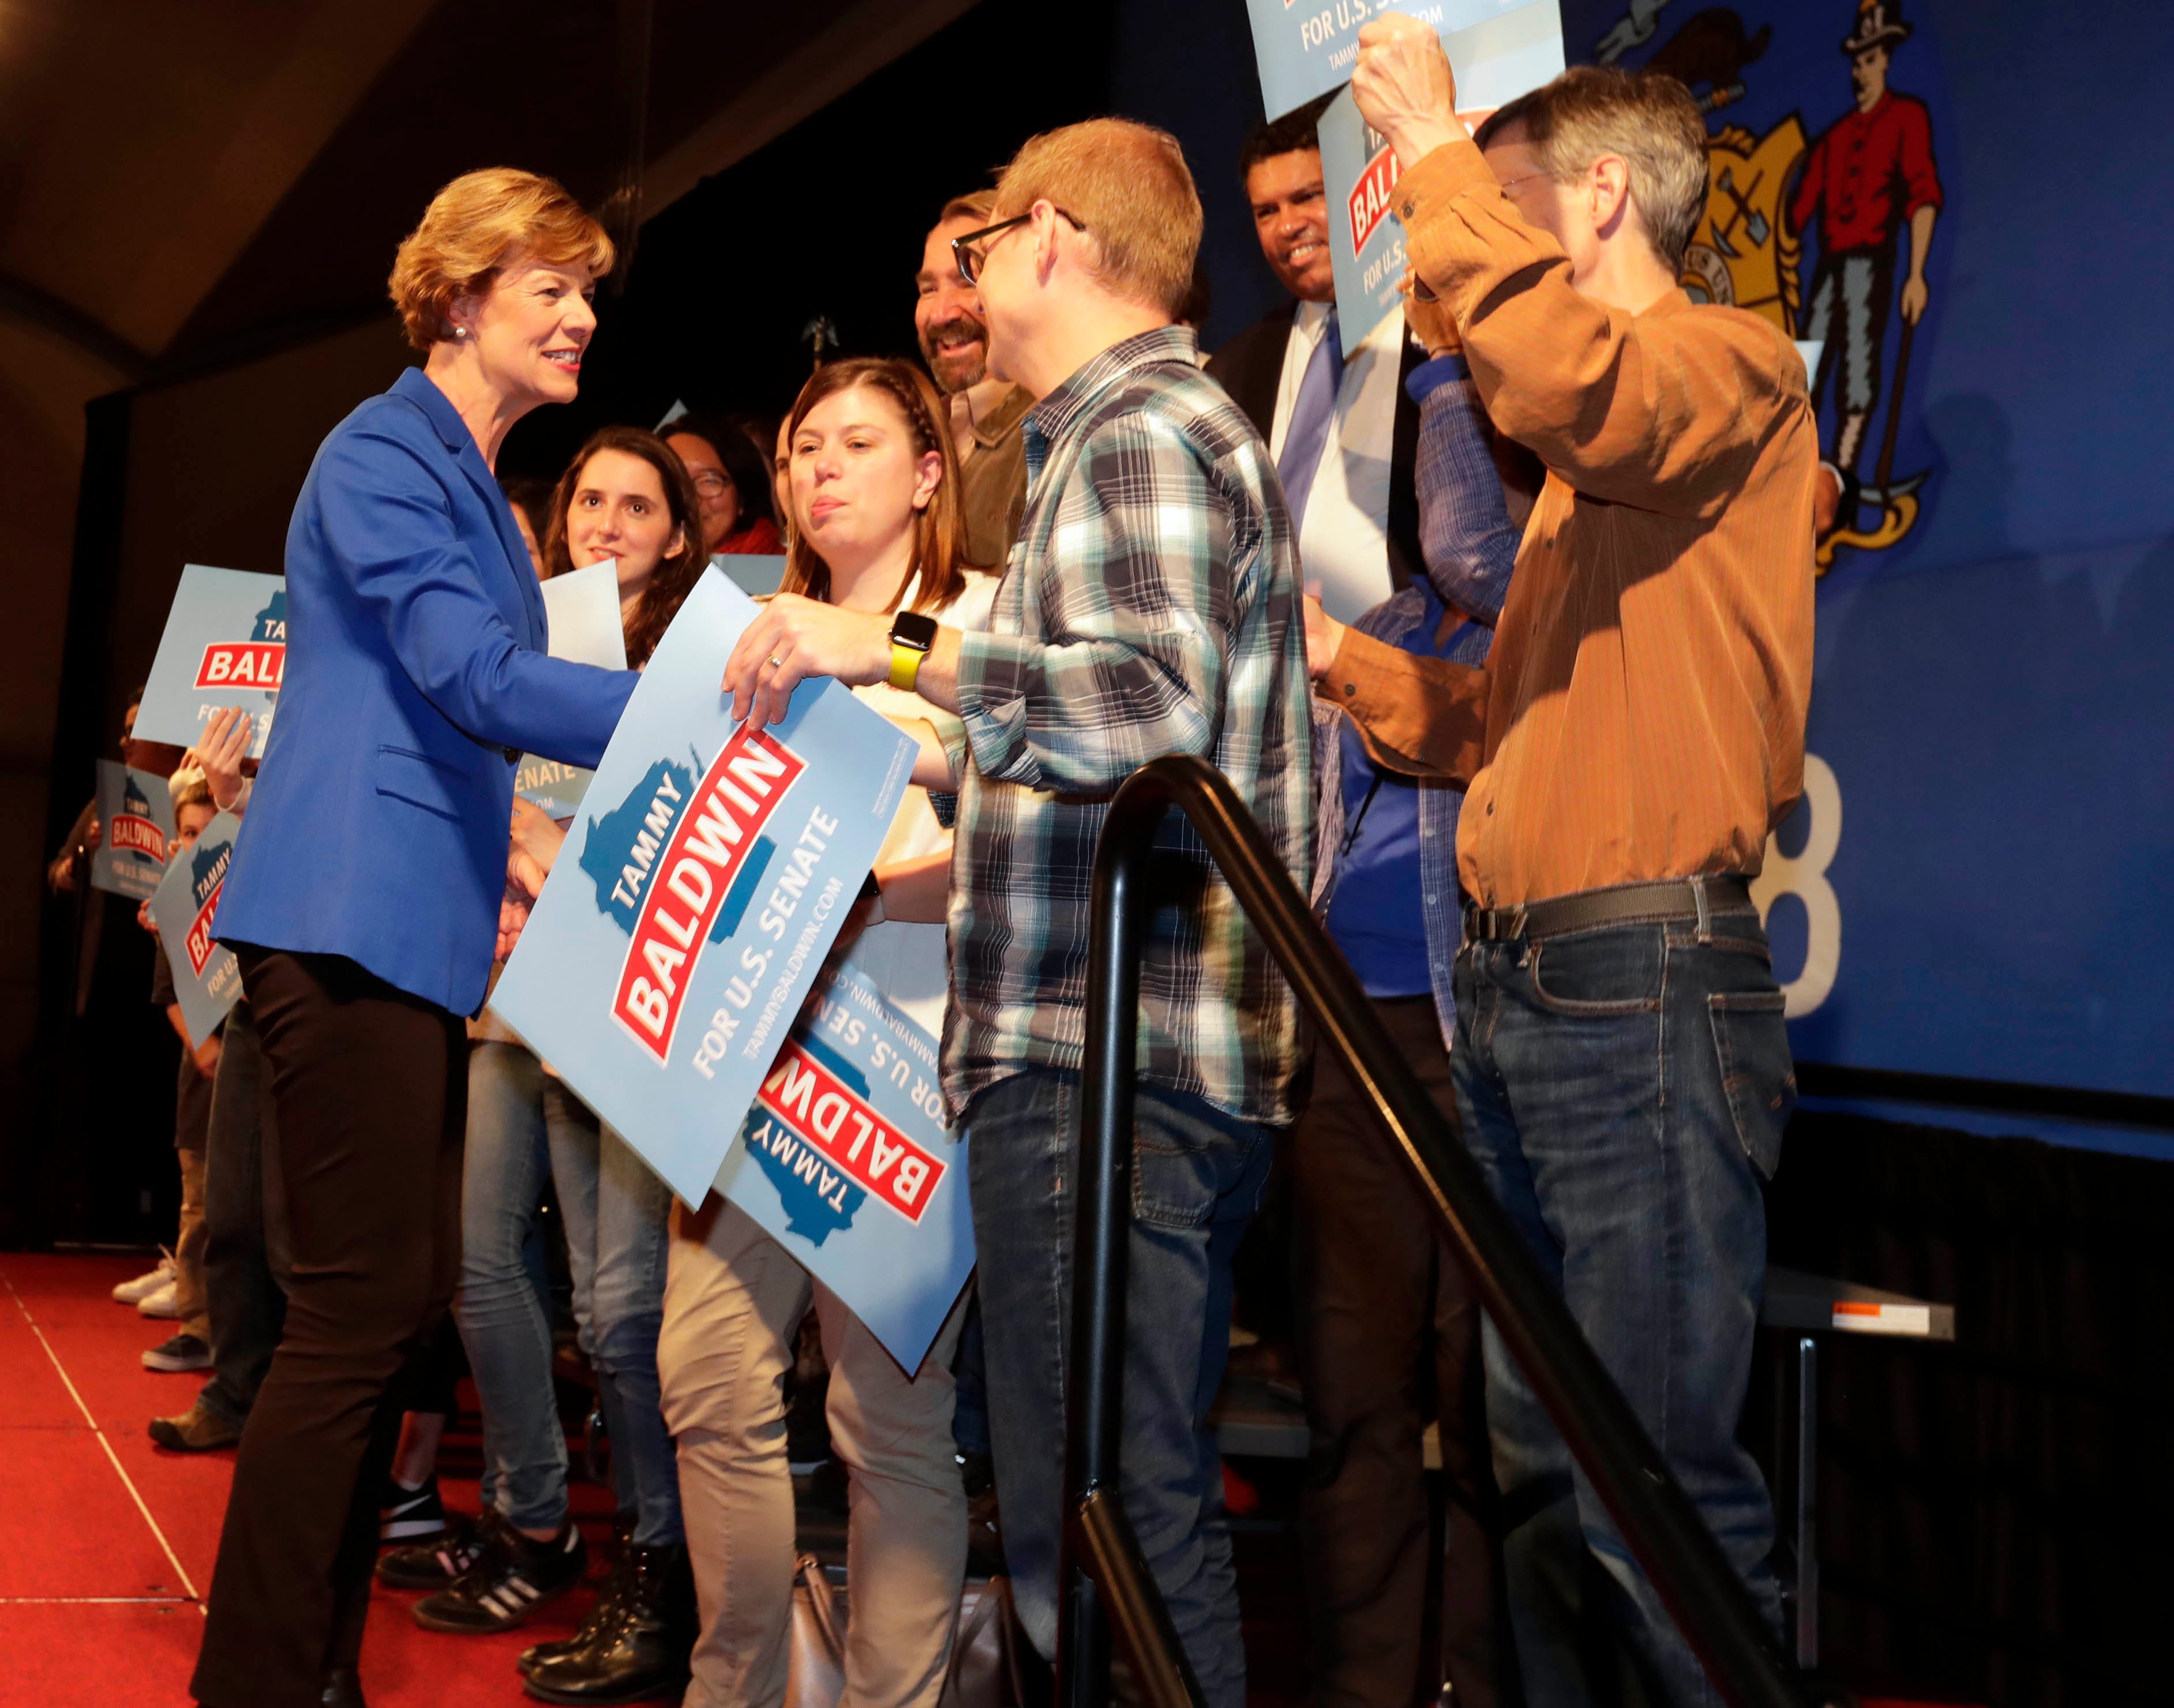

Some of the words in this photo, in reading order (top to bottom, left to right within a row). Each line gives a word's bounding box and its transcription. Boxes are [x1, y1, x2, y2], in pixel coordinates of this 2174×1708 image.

[1300, 10, 1336, 51] FOR
[1336, 0, 1372, 31] U.S.
[1411, 5, 1442, 24] OM
[1363, 259, 1382, 295] FOR
[265, 619, 286, 639] TA
[197, 704, 224, 721] FO
[534, 796, 554, 810] OM
[114, 821, 163, 857] BALDWIN
[611, 770, 682, 909] TAMMY
[197, 847, 231, 900] TAMMY
[626, 736, 788, 1039] BALDWIN
[1749, 752, 1842, 1018] 8
[692, 1007, 740, 1080] FOR
[724, 945, 774, 1009] U.S.
[759, 804, 839, 942] SENATE
[208, 969, 226, 998] FOR
[743, 877, 844, 1061] TAMMYBALDWIN.COM
[871, 1033, 911, 1089] U.S.
[765, 1056, 930, 1207] BALDW
[752, 1119, 848, 1213] TAMMY
